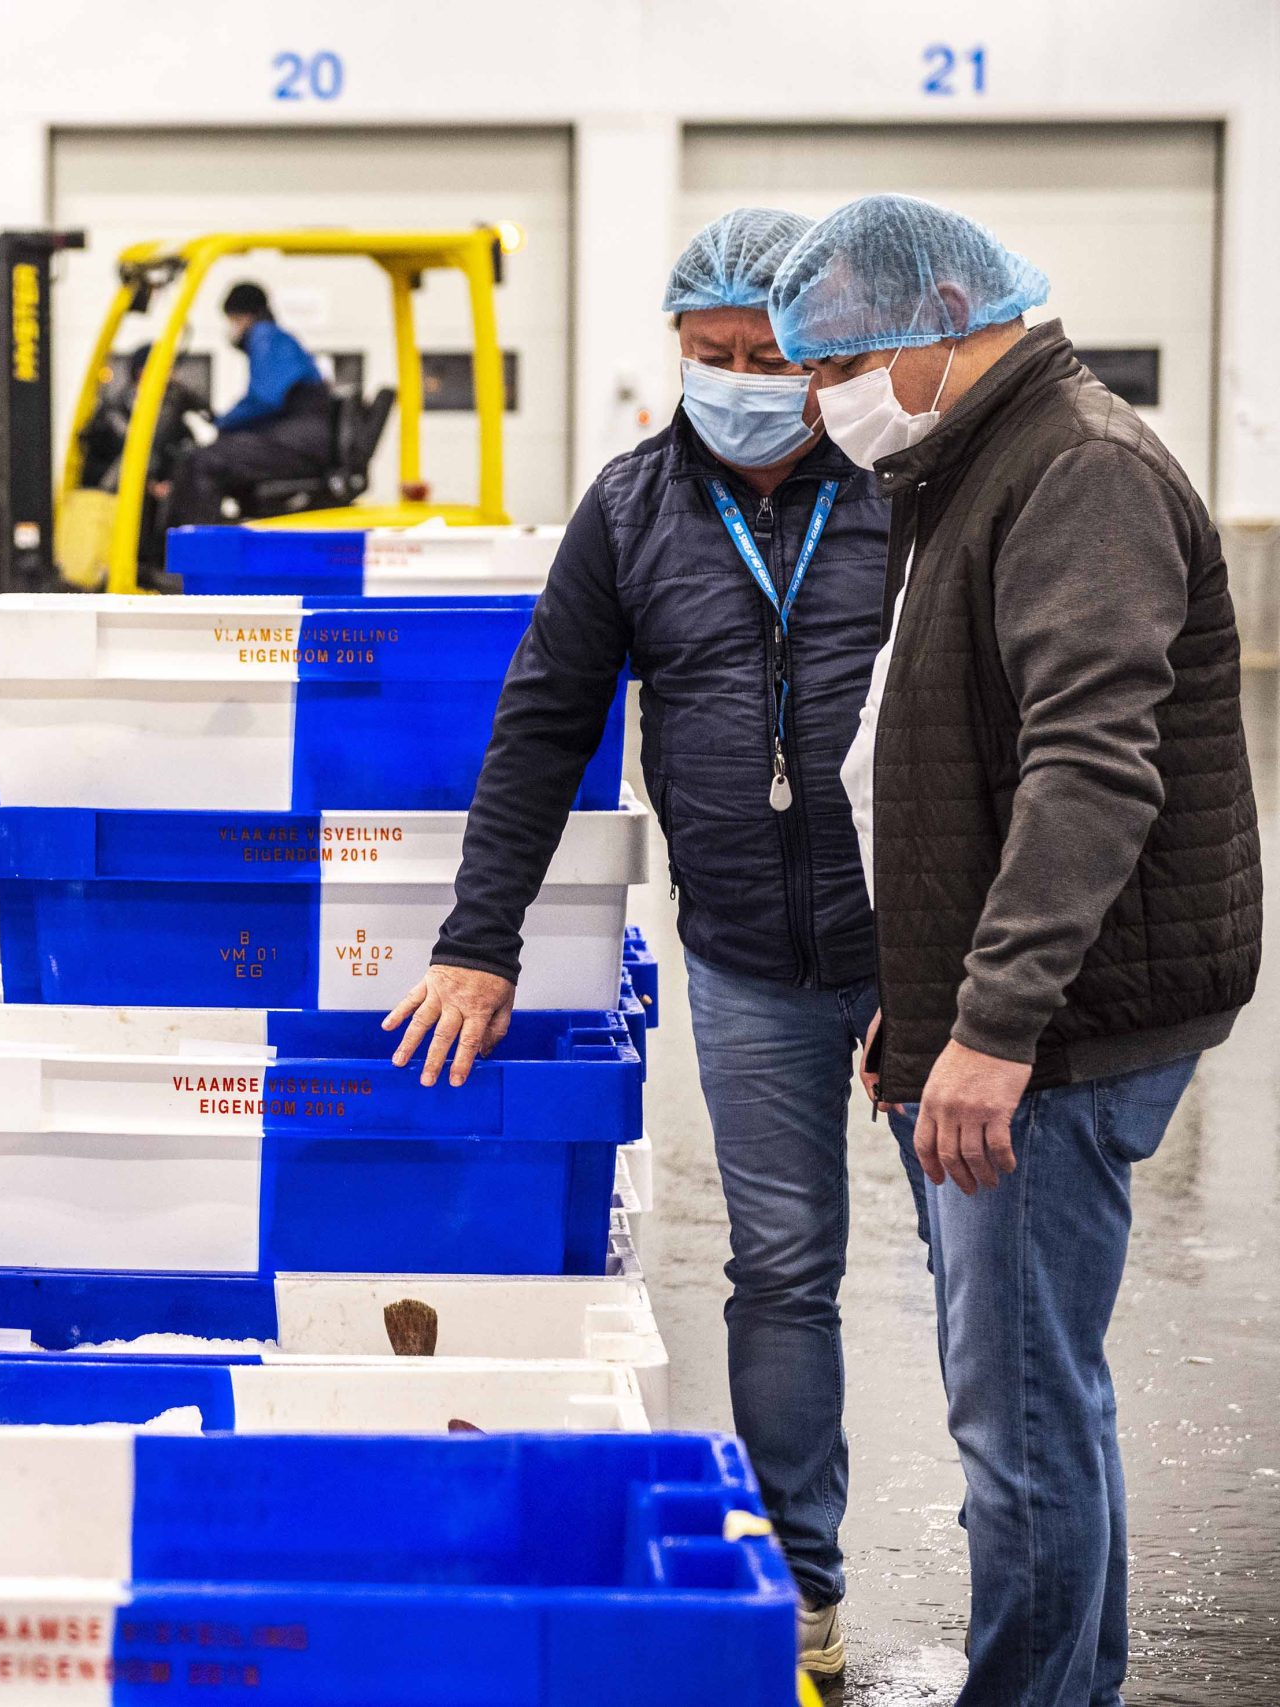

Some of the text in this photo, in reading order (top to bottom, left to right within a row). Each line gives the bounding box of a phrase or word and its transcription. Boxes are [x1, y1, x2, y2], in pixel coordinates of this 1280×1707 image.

[271, 51, 344, 100] 20
[923, 46, 986, 95] 21
[214, 628, 399, 642] VLAAMSE VISVEILING
[239, 649, 374, 663] EIGENDOM 2016
[243, 848, 378, 862] EIGENDOM 2016
[240, 931, 250, 945] B
[356, 929, 366, 943] B
[220, 948, 277, 961] VM 01
[335, 946, 393, 960] VM 02
[235, 964, 263, 978] EG
[352, 963, 378, 977] EG
[173, 1076, 371, 1094] VLAAMSE VISVEILING
[200, 1099, 345, 1116] EIGENDOM 2016
